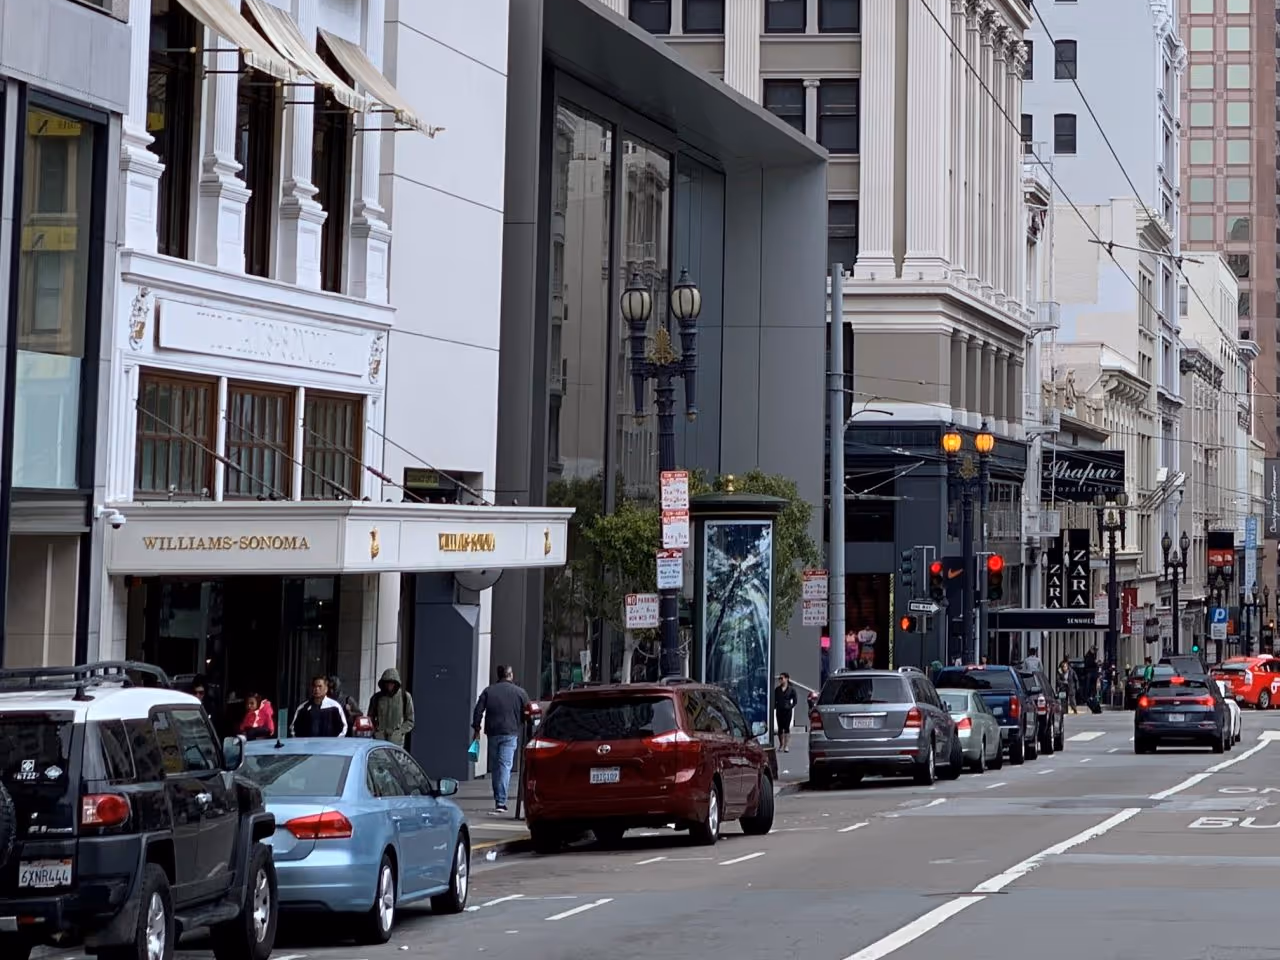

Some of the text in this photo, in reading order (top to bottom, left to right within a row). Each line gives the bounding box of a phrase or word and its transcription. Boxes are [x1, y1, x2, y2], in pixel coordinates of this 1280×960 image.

[1043, 460, 1121, 486] Shapur
[143, 535, 310, 552] WILLIAMS-SONOMA
[1049, 564, 1061, 608] ZARA
[1071, 550, 1087, 606] ZARA
[627, 595, 636, 606] NO
[21, 869, 69, 884] 6XNR444
